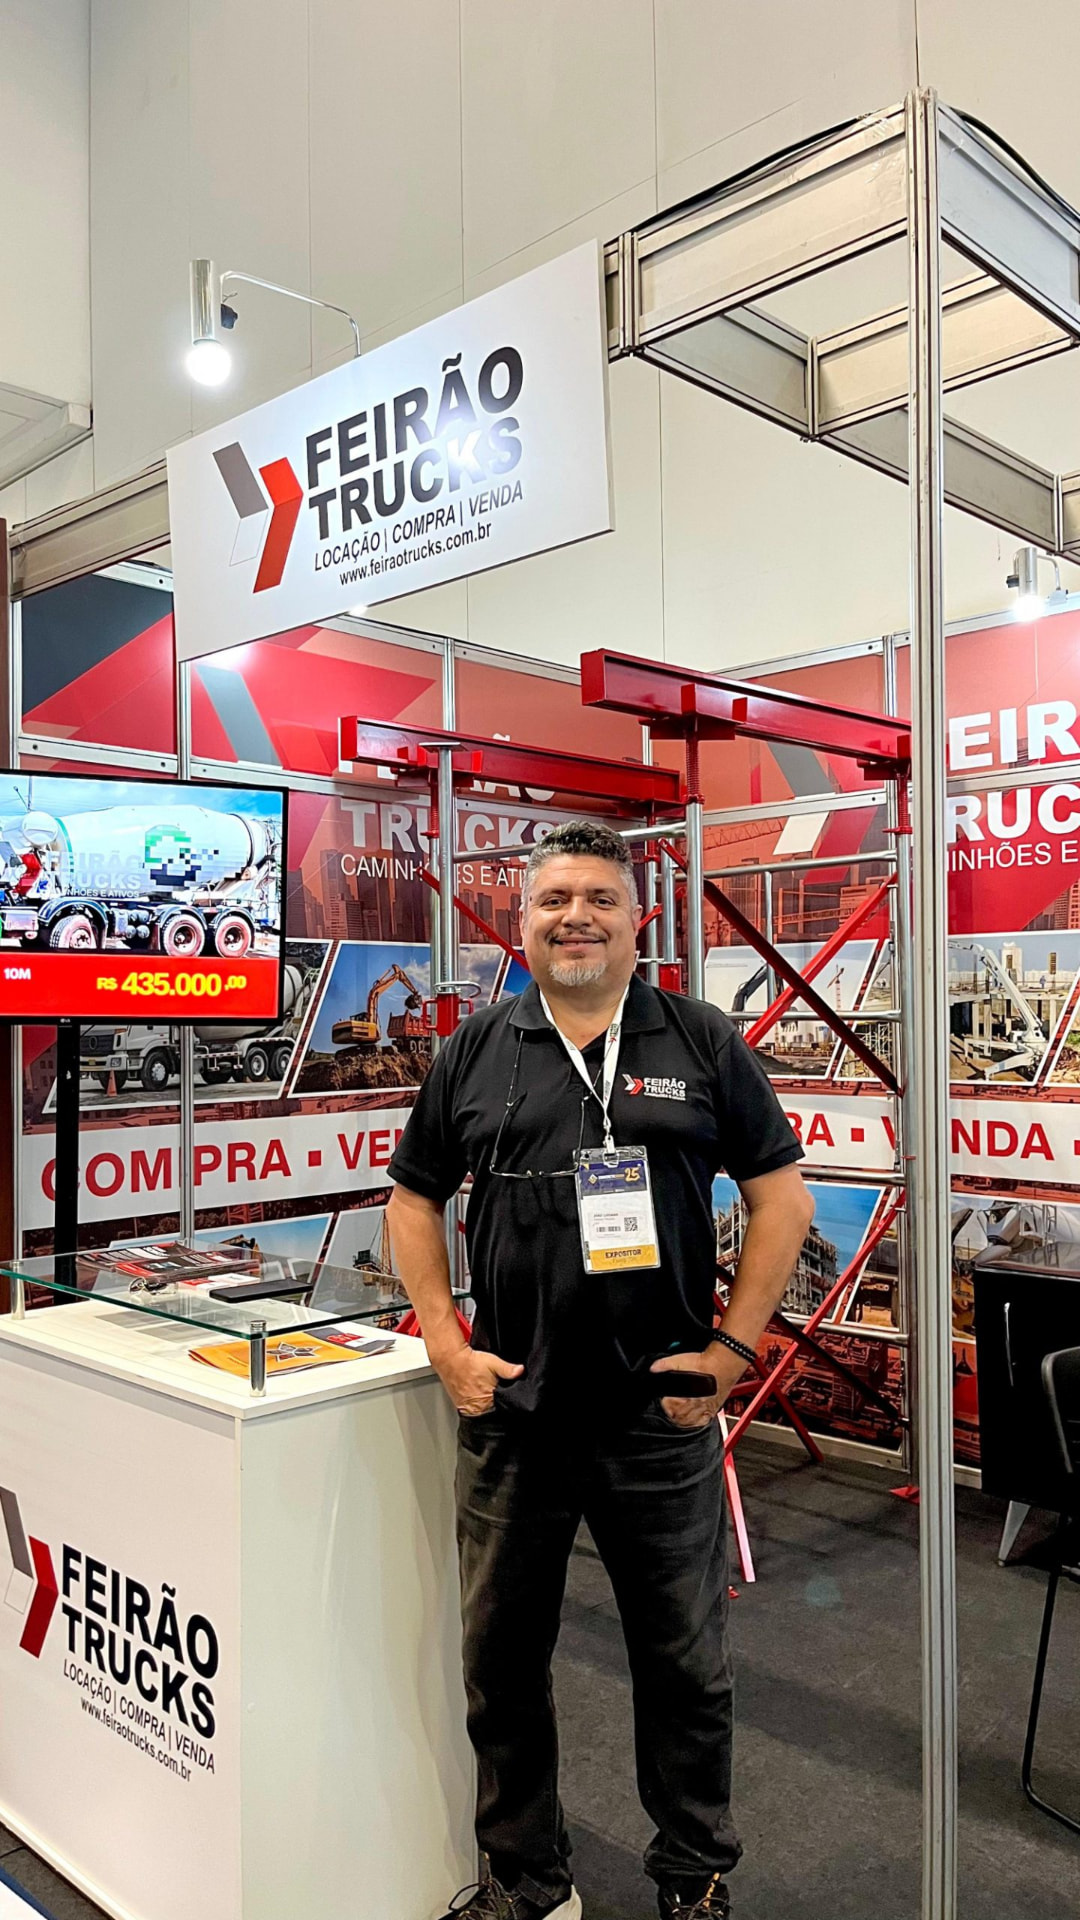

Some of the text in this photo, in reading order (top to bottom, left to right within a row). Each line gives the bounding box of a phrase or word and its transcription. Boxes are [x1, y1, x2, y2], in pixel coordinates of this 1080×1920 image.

[305, 346, 524, 490] FEIRÃO
[308, 416, 523, 541] TRUCKS
[314, 480, 524, 572] LOCAÇÃO COMPRA VENDA
[339, 521, 492, 587] www.feiraotrucks.com.br
[948, 700, 1080, 771] EIR
[947, 783, 1080, 844] RUC
[481, 866, 492, 886] E
[1061, 840, 1079, 864] E
[3, 967, 31, 980] 10M
[121, 972, 222, 996] 435.000
[643, 1077, 686, 1090] FEIRÃO
[643, 1085, 686, 1097] TRUCKS
[624, 1167, 640, 1182] 25
[605, 1248, 642, 1259] EXPOSITOR
[62, 1543, 219, 1679] FEIRÃO
[62, 1602, 216, 1739] TRUCKS
[63, 1658, 215, 1774] LOCAÇÃO COMPRA VENDA
[80, 1697, 192, 1782] www.feiraotrucks.com.br
